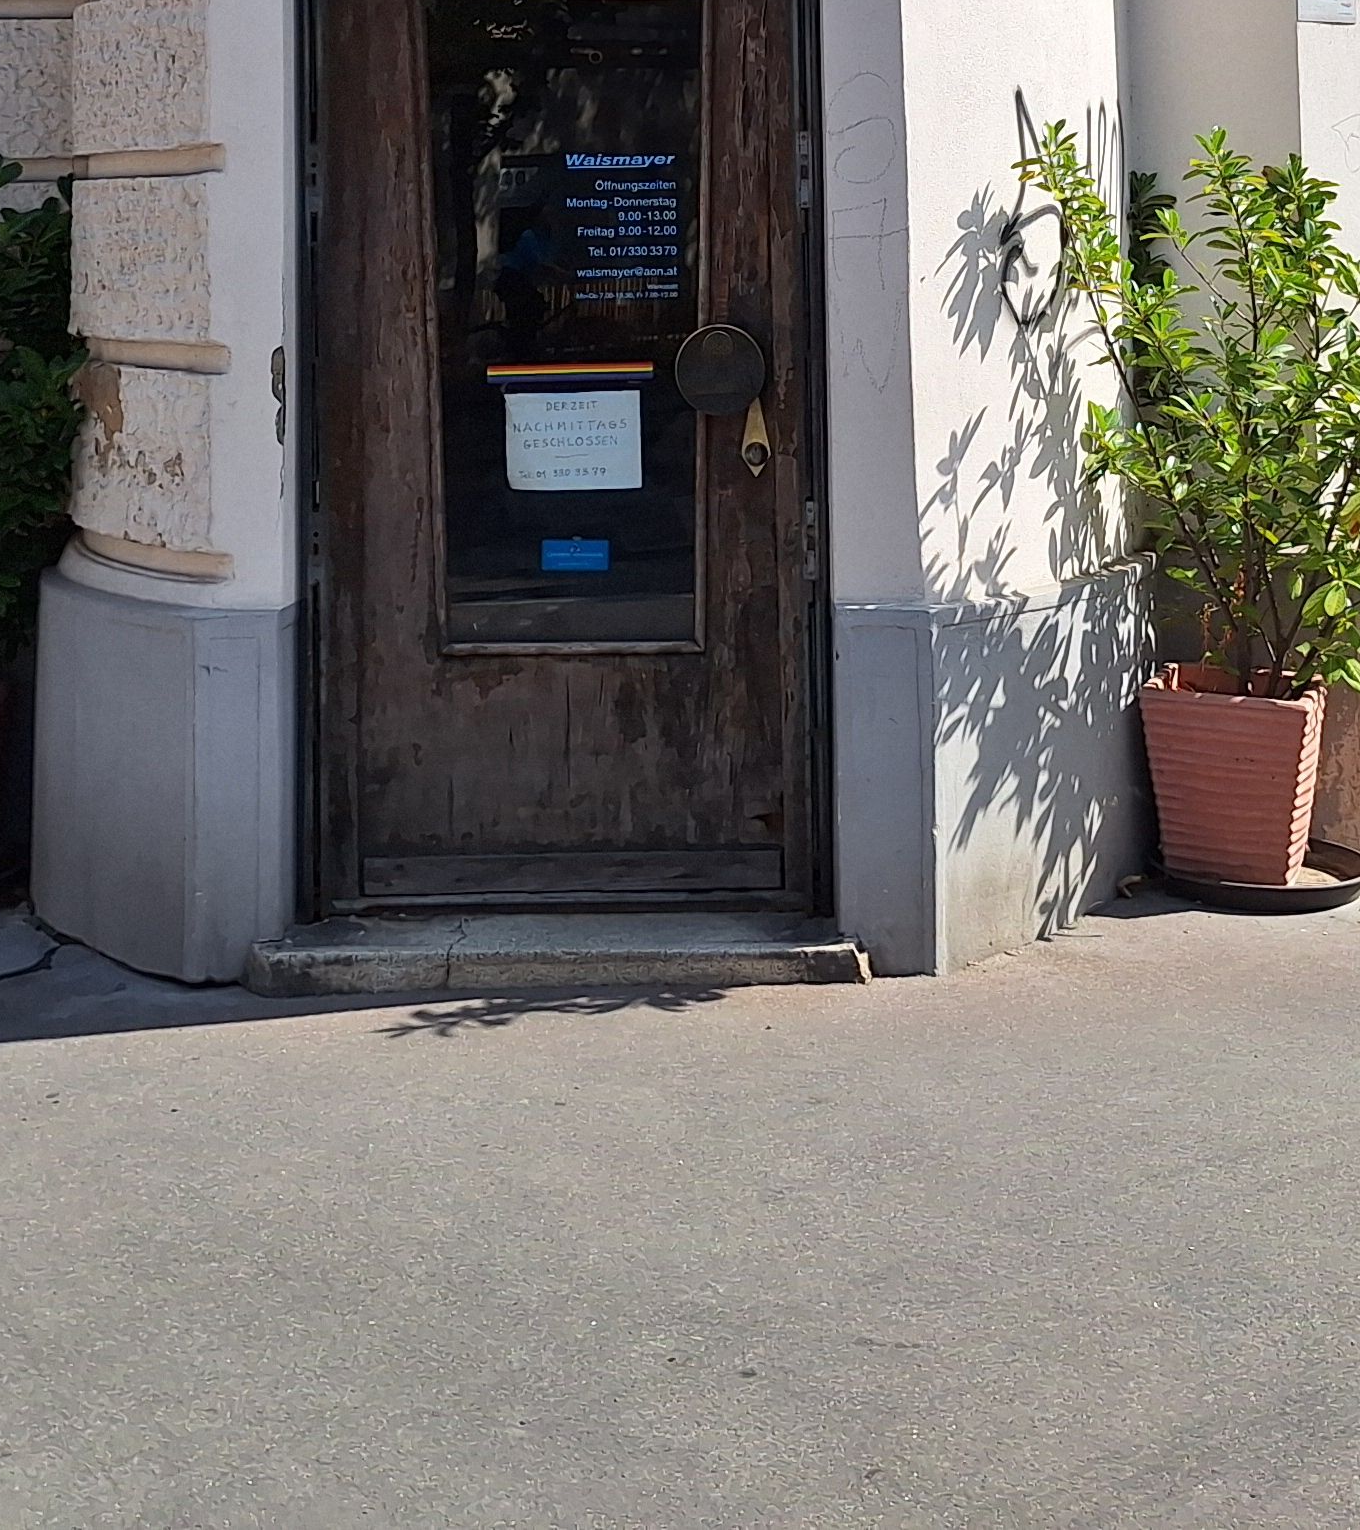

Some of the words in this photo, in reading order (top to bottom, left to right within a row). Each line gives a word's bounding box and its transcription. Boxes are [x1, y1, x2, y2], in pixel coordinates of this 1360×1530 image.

[565, 153, 676, 169] Waismayer
[594, 179, 677, 193] Öffnungszeiten
[577, 226, 615, 239] Freitag
[587, 246, 607, 257] Tel.
[576, 266, 678, 279] waismayer@aon.at
[545, 400, 599, 412] DERZEIT
[512, 418, 628, 434] NACHMITTAGS
[522, 435, 618, 451] GESCHLOSSEN
